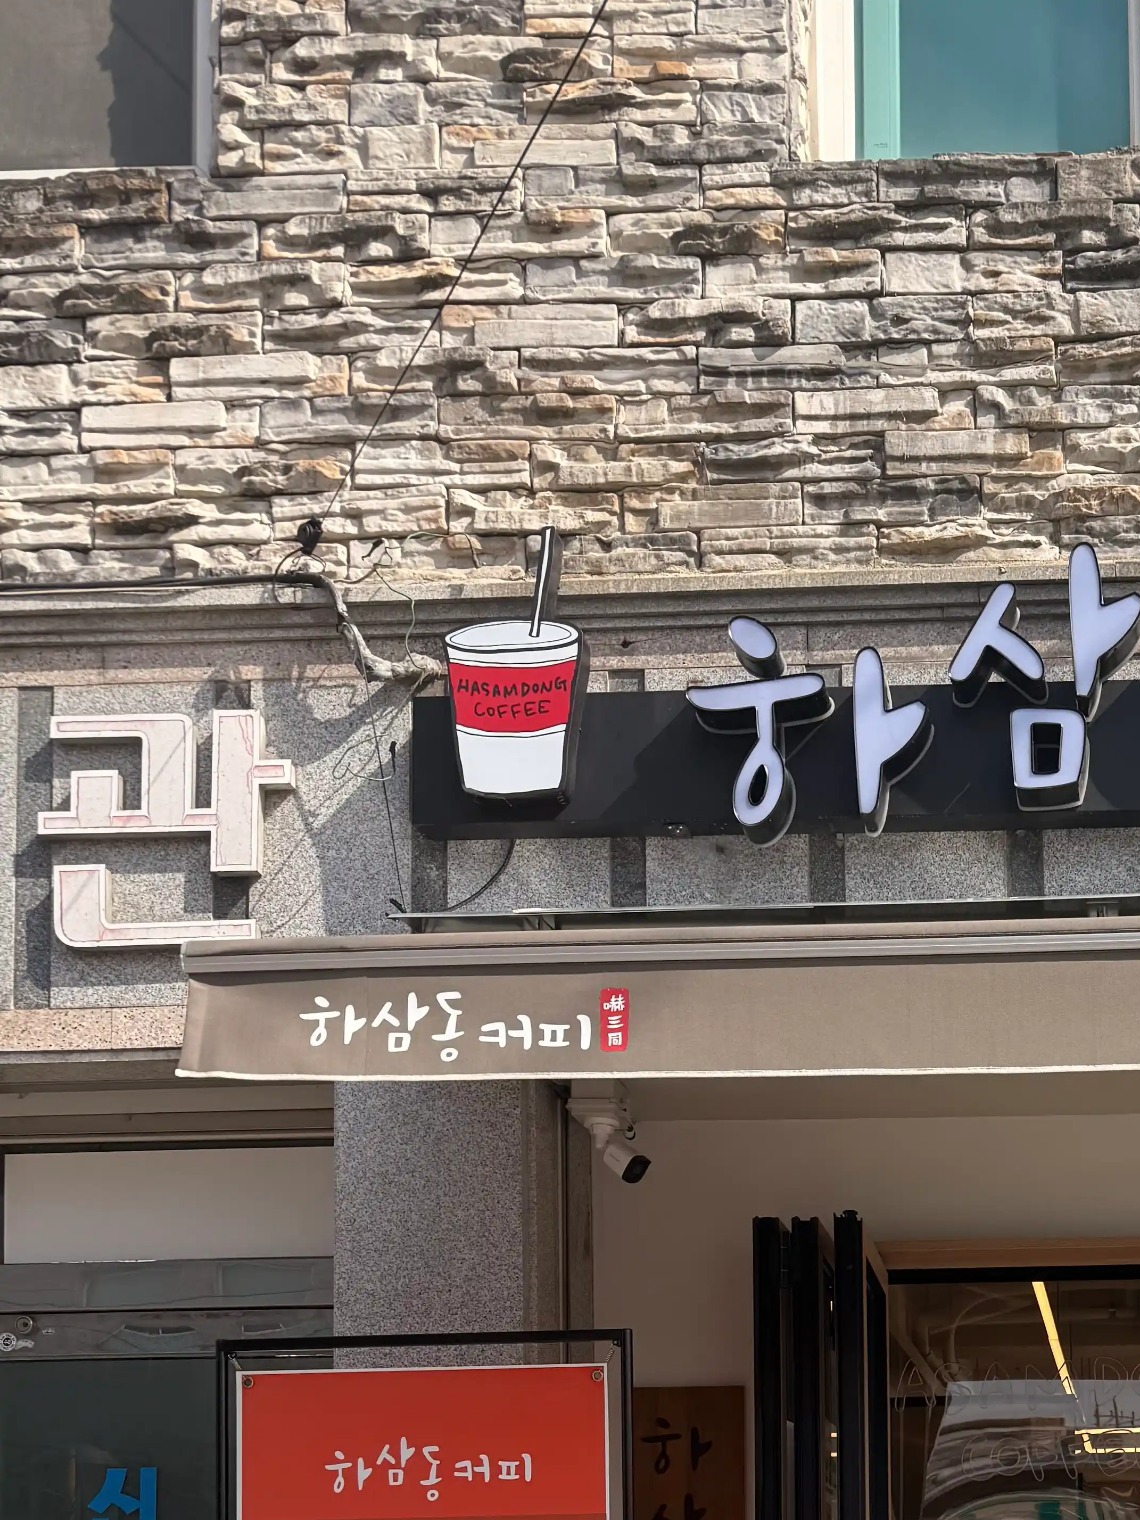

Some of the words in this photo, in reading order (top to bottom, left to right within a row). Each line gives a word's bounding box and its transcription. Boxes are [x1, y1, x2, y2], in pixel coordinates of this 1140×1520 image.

[457, 677, 567, 698] HASAMDONG
[474, 700, 551, 719] COFFEE
[37, 708, 296, 948] 관
